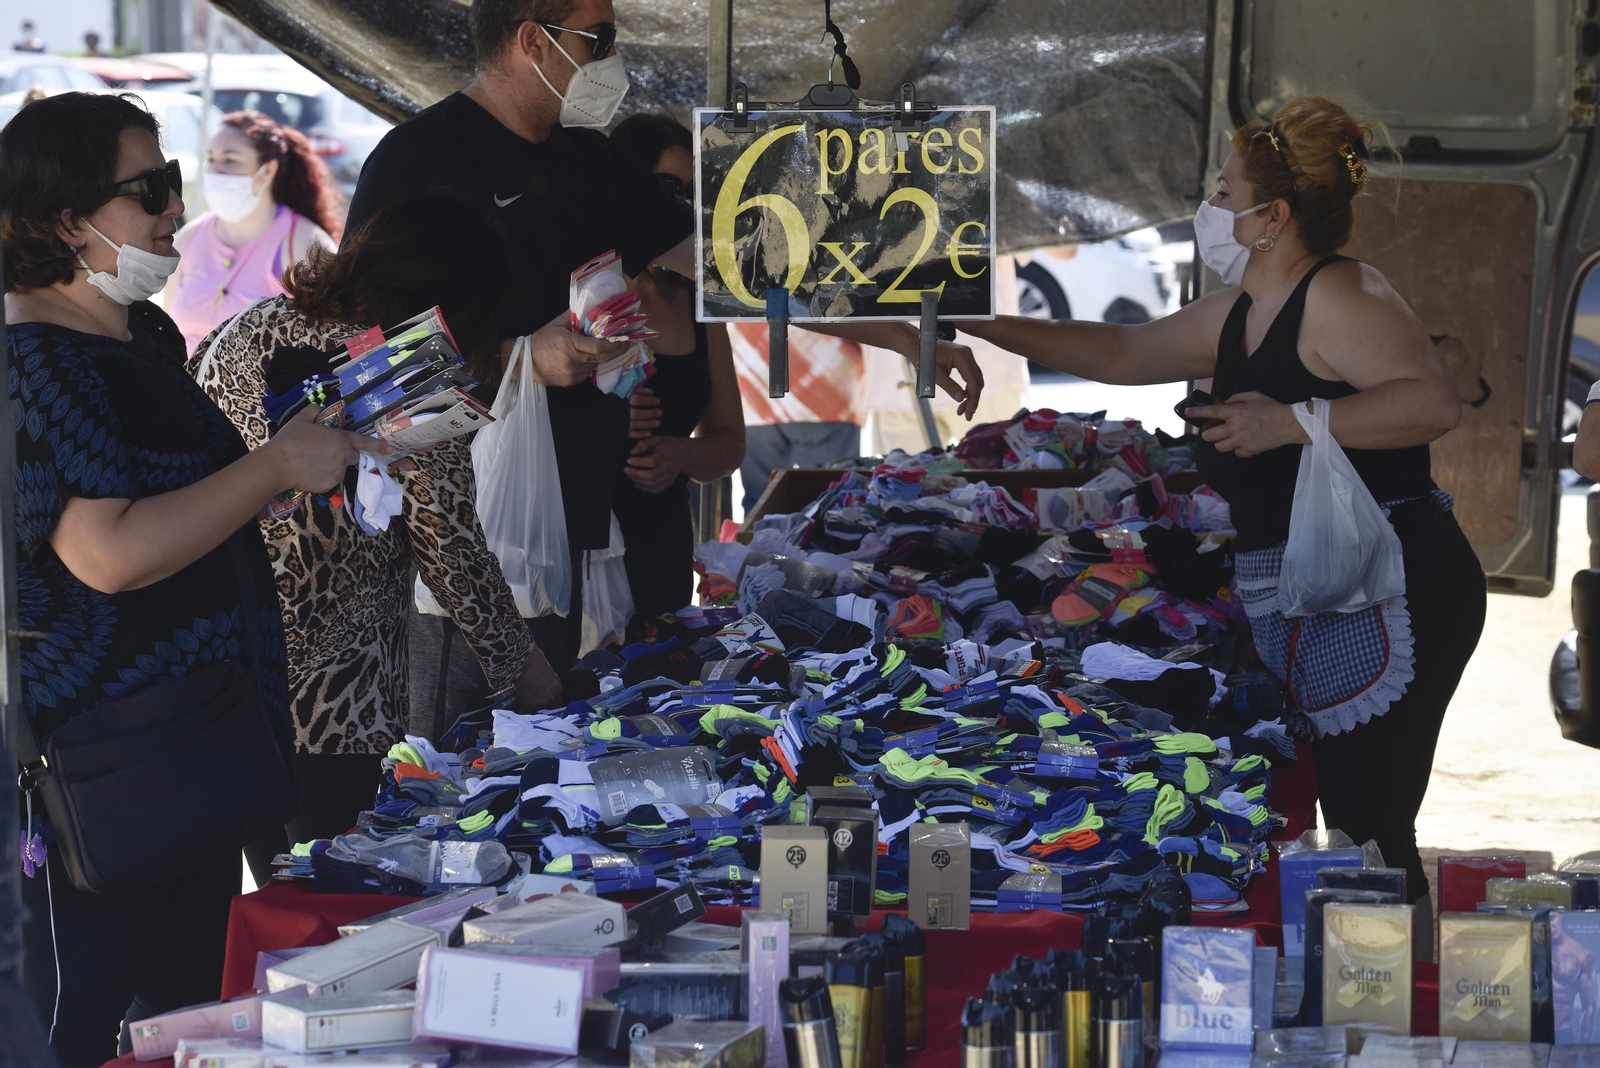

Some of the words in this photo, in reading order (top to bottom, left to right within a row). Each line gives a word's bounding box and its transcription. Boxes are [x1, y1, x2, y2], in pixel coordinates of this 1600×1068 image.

[712, 125, 810, 307] 6
[814, 127, 985, 195] pares
[836, 832, 851, 845] 42
[788, 849, 804, 862] 25
[933, 852, 949, 864] 25
[1338, 964, 1392, 983] Golden
[1354, 982, 1384, 994] Man
[1455, 977, 1511, 997] Golden
[1472, 995, 1502, 1008] Man
[1174, 1003, 1234, 1030] blue
